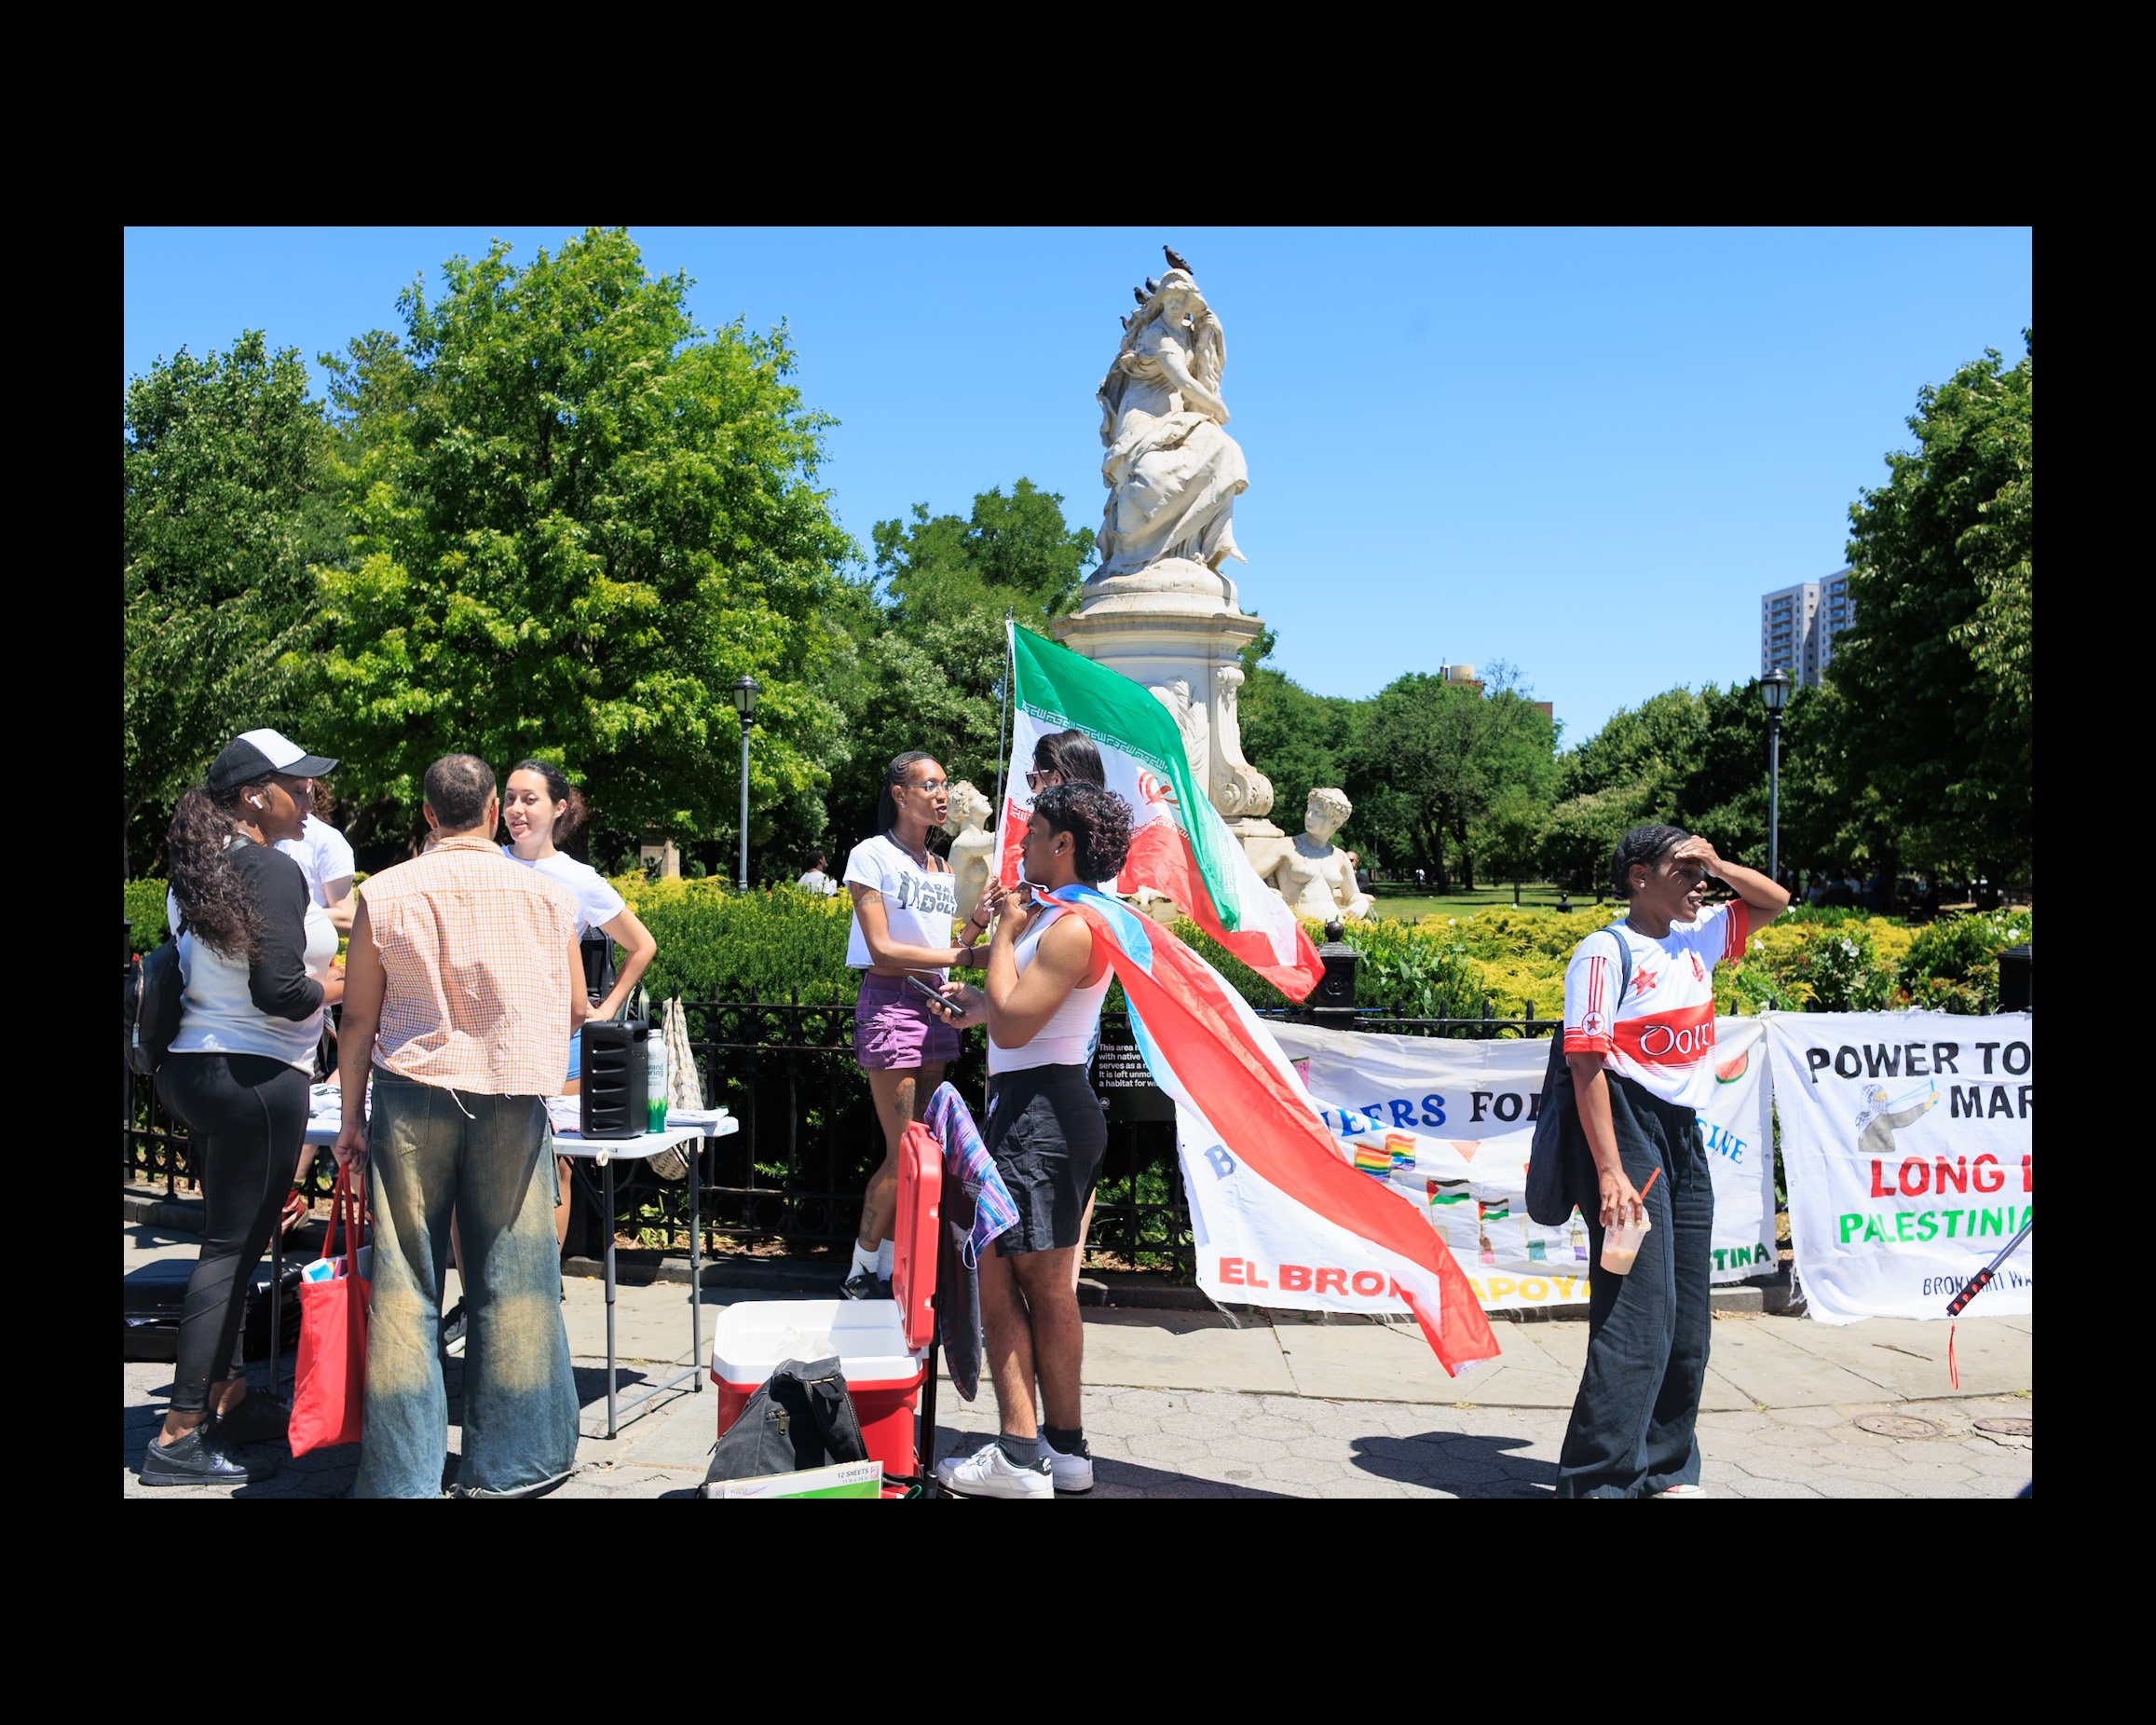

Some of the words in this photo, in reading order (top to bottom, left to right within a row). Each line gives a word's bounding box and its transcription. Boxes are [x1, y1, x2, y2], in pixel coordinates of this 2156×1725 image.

[1114, 1070, 1127, 1078] left
[1806, 1042, 1959, 1083] POWER
[1975, 1041, 2031, 1075] TO
[1106, 1079, 1133, 1088] habitat
[1134, 1079, 1145, 1088] for
[1320, 1093, 1447, 1137] EERS
[1871, 1154, 2005, 1198] LONG
[1220, 1257, 1269, 1289] EL
[1467, 1275, 1591, 1302] APOY
[846, 1468, 869, 1478] SHEETS
